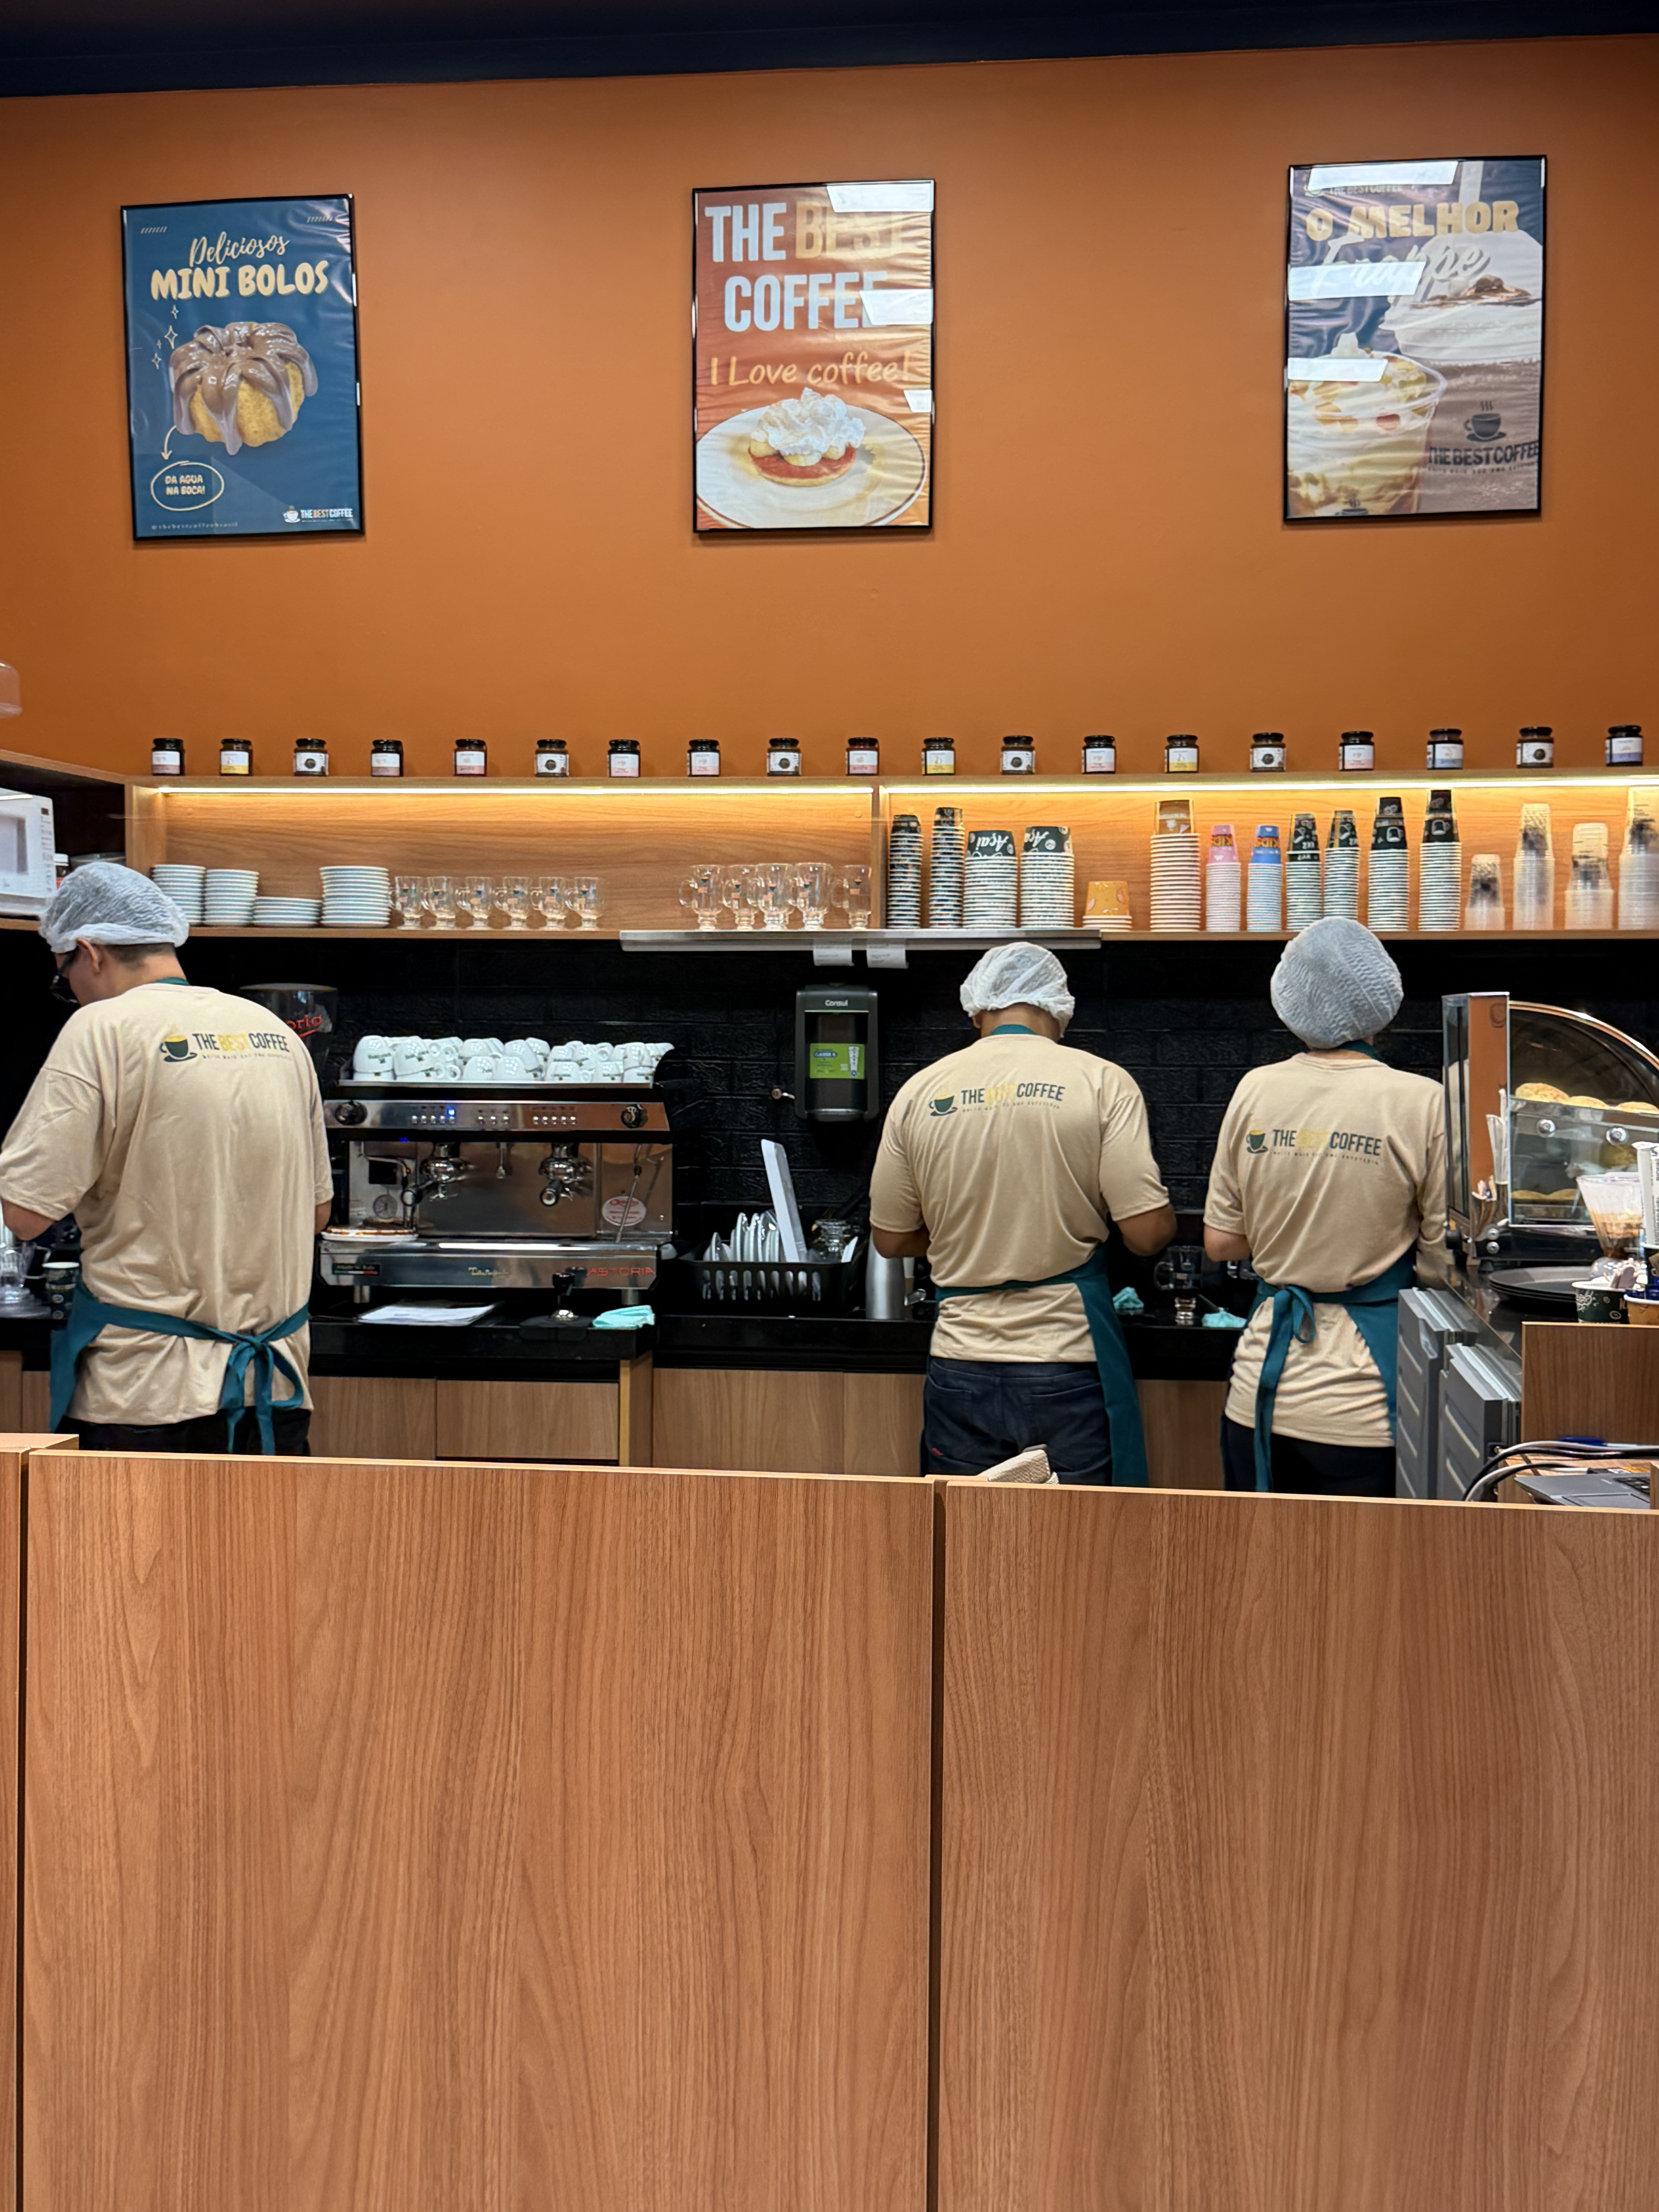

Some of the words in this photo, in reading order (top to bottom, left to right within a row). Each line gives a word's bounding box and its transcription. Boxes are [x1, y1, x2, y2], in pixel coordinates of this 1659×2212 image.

[704, 202, 787, 263] THE
[1306, 208, 1333, 241] O
[1348, 201, 1519, 239] MELHOR
[189, 231, 290, 267] Deliciosos
[151, 266, 231, 300] MINI
[238, 260, 329, 297] BOLOS
[710, 357, 718, 386] I
[729, 356, 797, 386] Love
[806, 350, 911, 385] coffee!
[1453, 447, 1493, 465] BEST
[300, 509, 313, 518] THE
[313, 509, 329, 518] BEST
[329, 508, 353, 517] COFFEE
[192, 1033, 220, 1051] THE
[248, 1033, 290, 1053] COFFEE
[962, 1088, 985, 1105] THE
[1017, 1083, 1065, 1101] COFFEE
[1273, 1129, 1297, 1147] THE
[1330, 1131, 1382, 1156] COFFEE
[587, 1267, 656, 1277] ASTORIA
